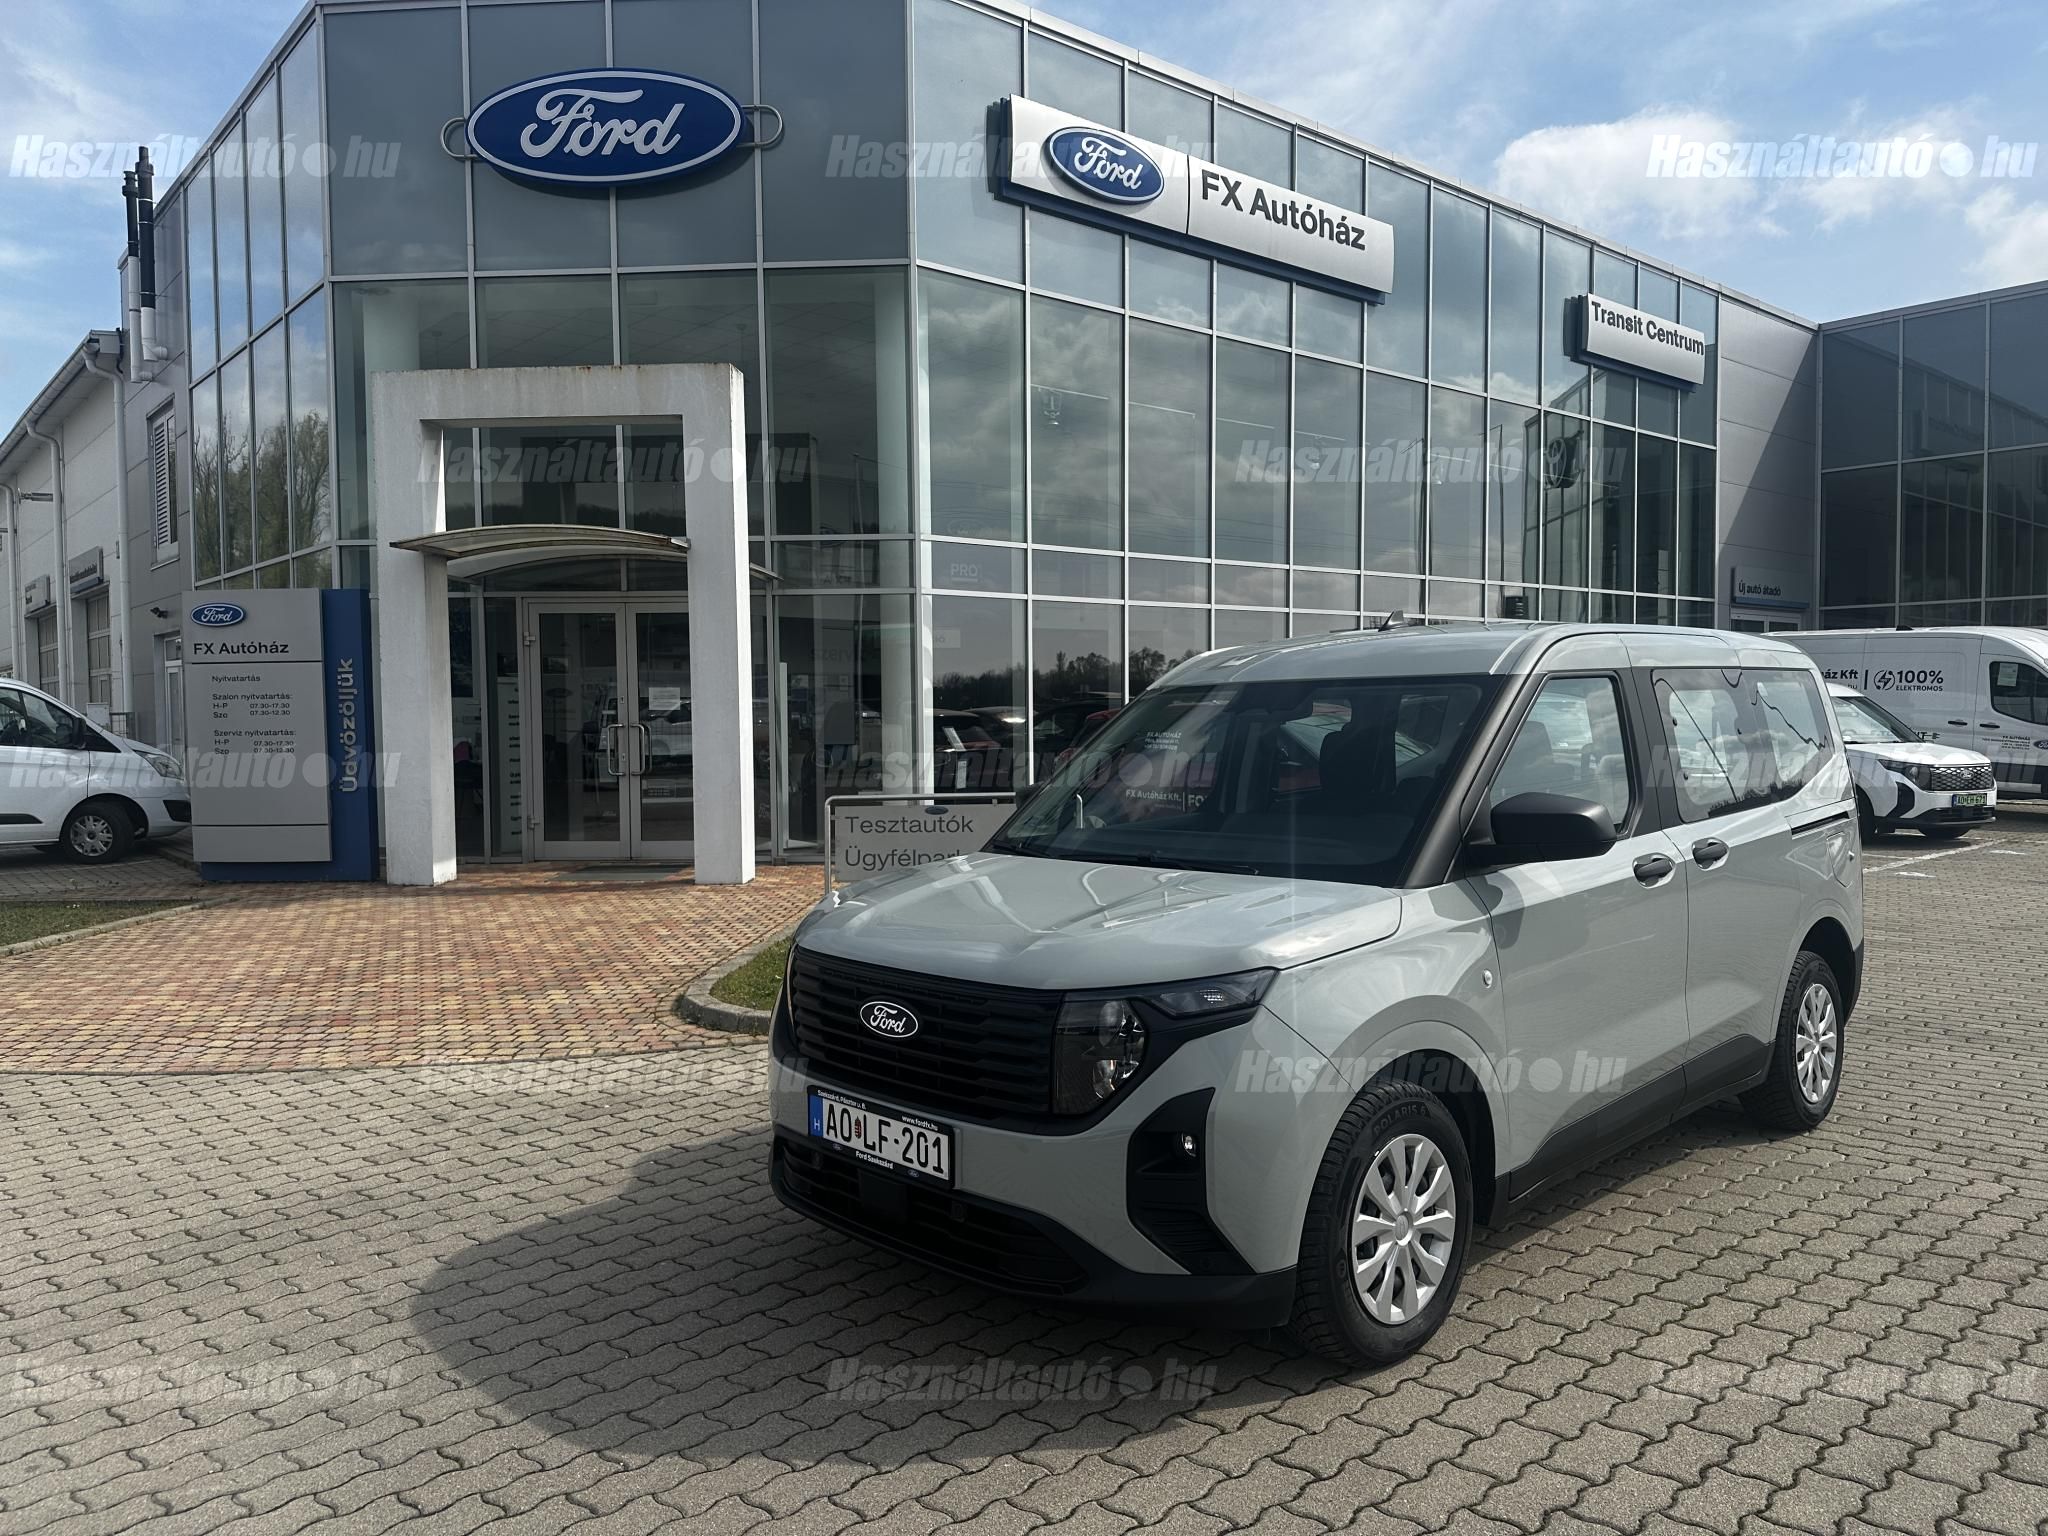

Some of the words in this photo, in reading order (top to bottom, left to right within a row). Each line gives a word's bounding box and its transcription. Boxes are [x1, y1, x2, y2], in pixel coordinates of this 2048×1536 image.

[520, 88, 686, 158] Ford
[1073, 136, 1143, 191] Ford
[1201, 168, 1244, 212] FX
[1250, 187, 1366, 251] Autóház
[1591, 300, 1644, 336] Transit
[1646, 319, 1704, 356] Centrum
[201, 607, 233, 622] Ford
[193, 642, 214, 655] FX
[218, 640, 289, 655] Autóház
[212, 673, 261, 683] Nyitvatartás
[1840, 668, 1859, 680] Kft
[1896, 669, 1944, 685] 100%
[1896, 684, 1944, 692] ELEKTROMOS
[212, 692, 239, 701] Szalon
[337, 658, 358, 792] Üdvözöljük
[214, 729, 242, 737] Szerviz
[844, 815, 974, 834] Tesztautók
[870, 1005, 907, 1033] Ford
[813, 1117, 821, 1131] H
[855, 1150, 868, 1160] Ford
